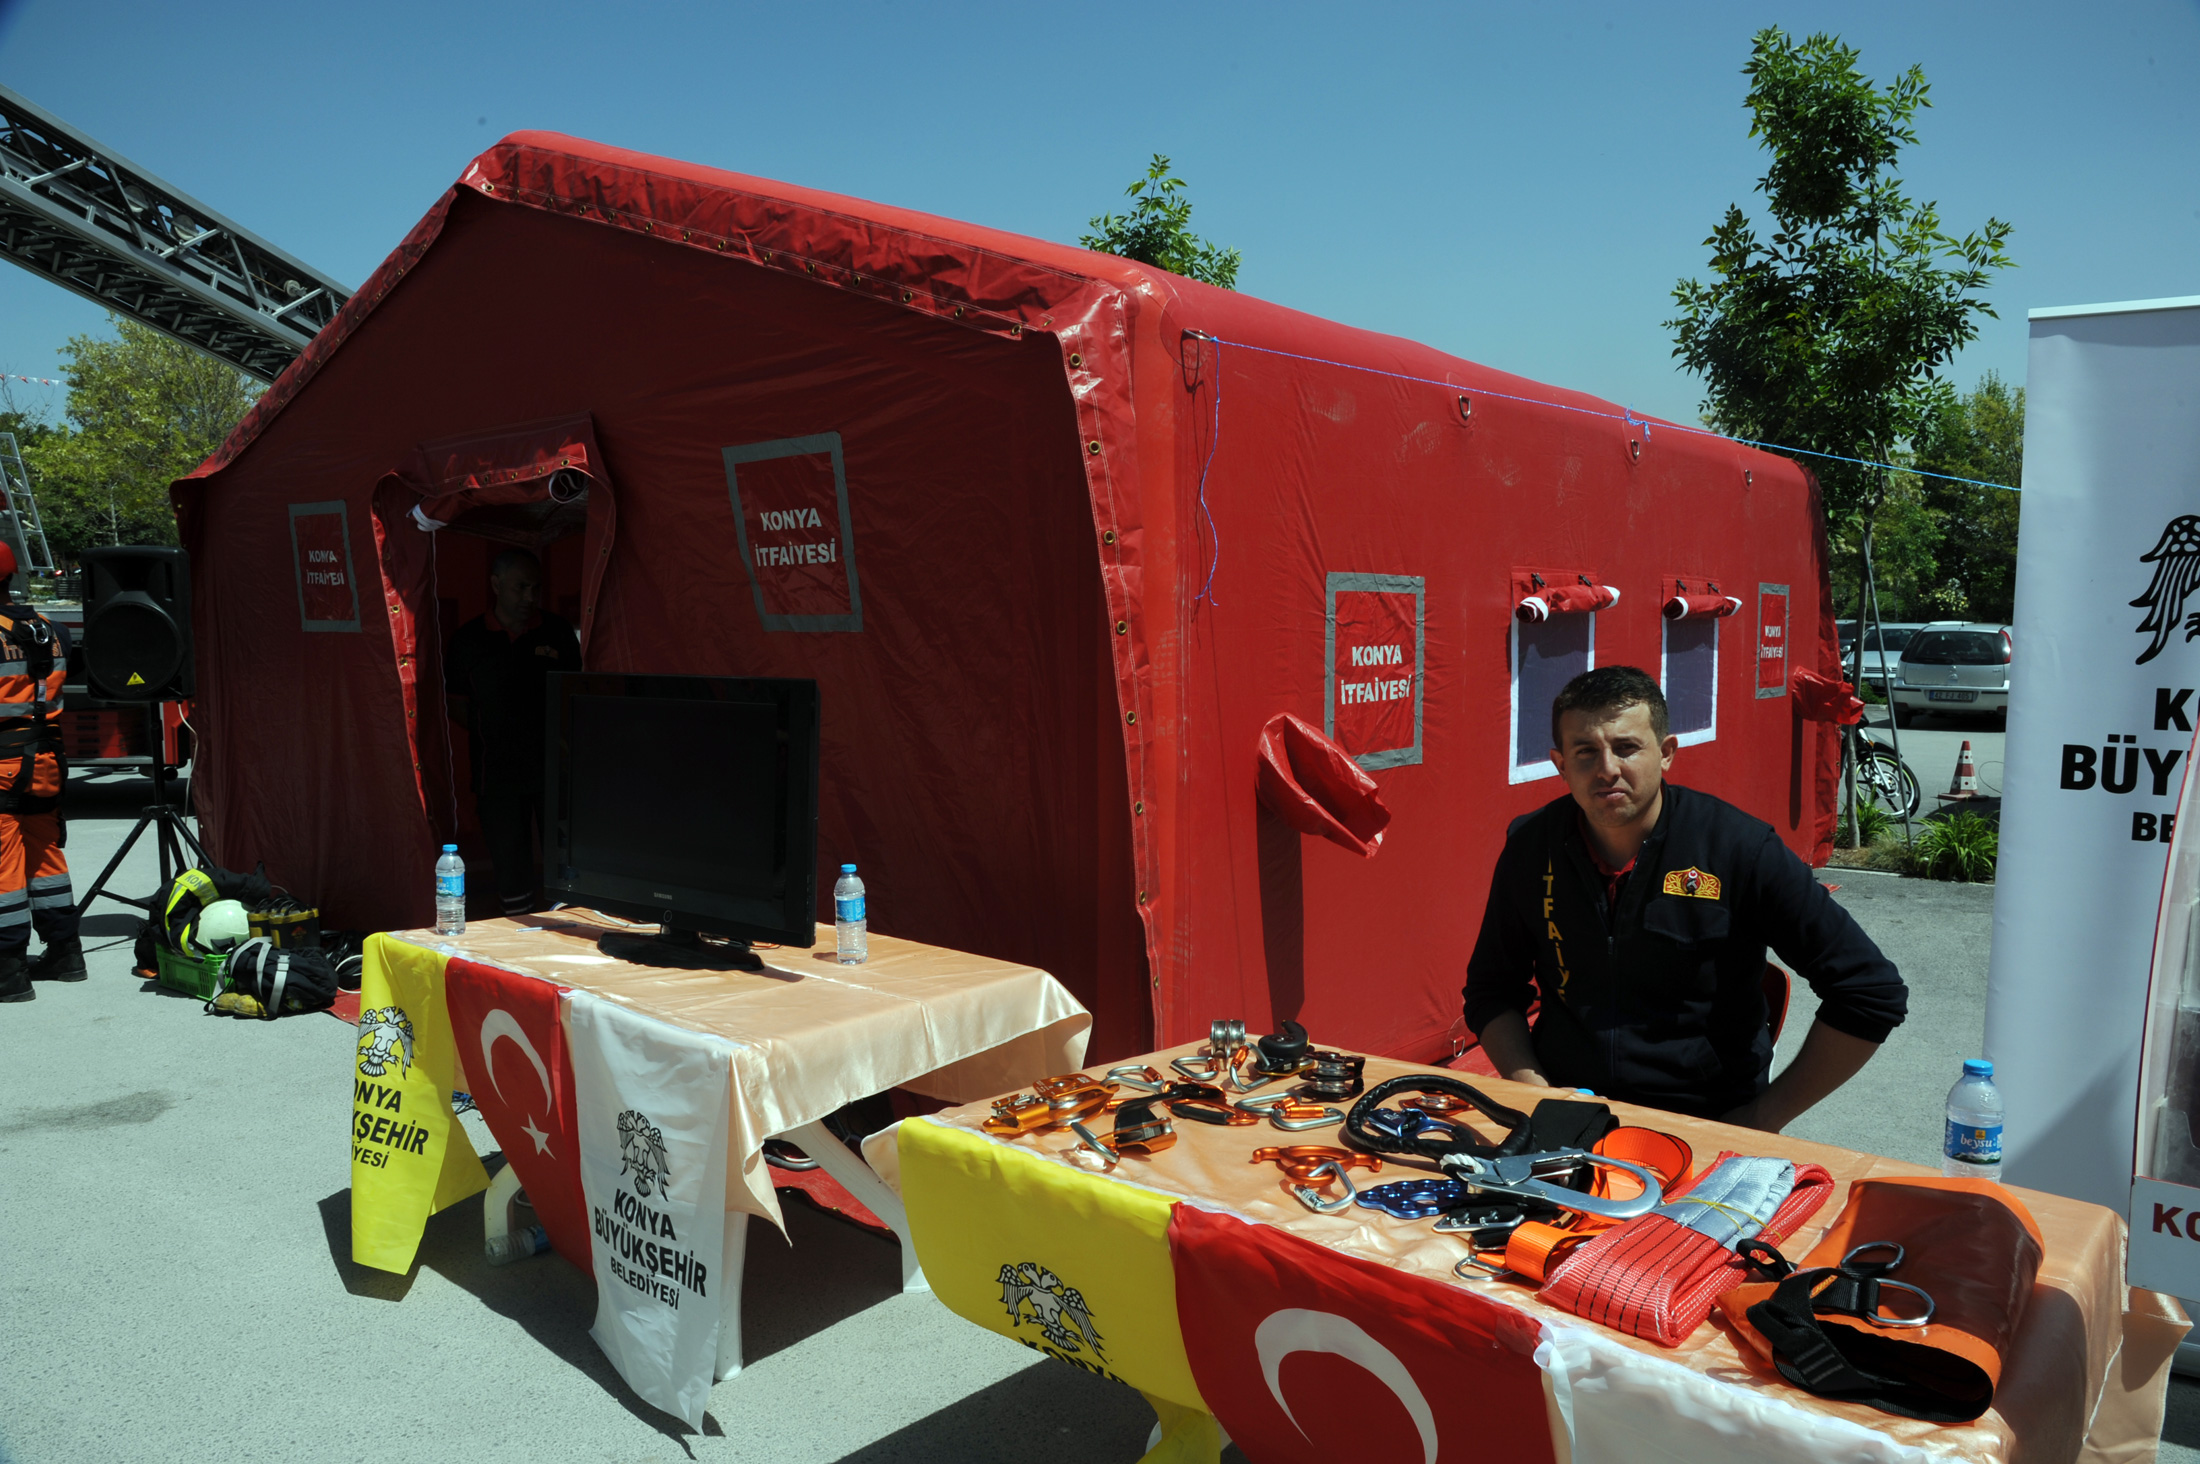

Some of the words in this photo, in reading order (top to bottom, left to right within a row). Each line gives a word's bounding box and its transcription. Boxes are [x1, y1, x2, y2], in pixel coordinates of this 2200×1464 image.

[761, 508, 822, 531] KONYA
[308, 550, 338, 563] KONYA
[755, 538, 836, 567] İTFAİYESİ
[1352, 645, 1402, 667] KONYA
[1341, 674, 1412, 705] İTFAİYESİ
[2154, 688, 2200, 732] K
[2060, 734, 2191, 796] BÜY
[2131, 812, 2176, 843] BE
[1960, 1133, 1993, 1150] beysu
[614, 1188, 677, 1241] KONYA
[595, 1206, 707, 1298] BÜYÜKŞEHİR
[610, 1255, 680, 1311] BELEDİYESİ
